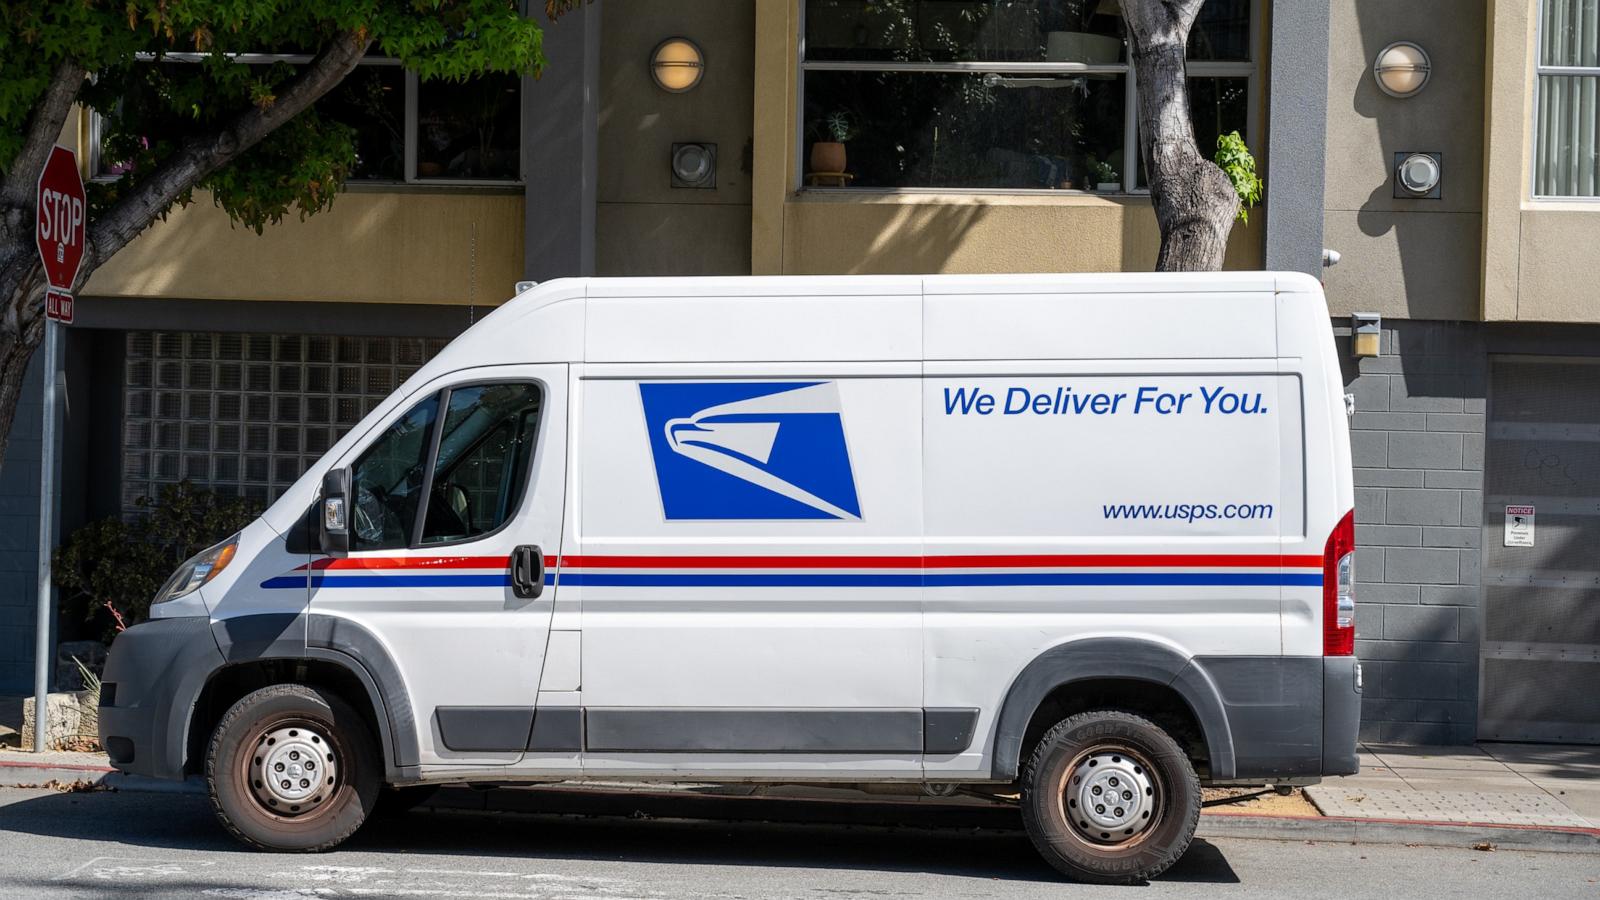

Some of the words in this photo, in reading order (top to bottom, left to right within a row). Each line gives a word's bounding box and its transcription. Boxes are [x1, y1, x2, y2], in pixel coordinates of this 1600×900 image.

[41, 188, 82, 246] STOP
[48, 297, 59, 315] ALL
[60, 299, 72, 317] WAY
[943, 387, 995, 415] We
[1003, 386, 1127, 415] Deliver
[1134, 386, 1193, 415] For
[1200, 386, 1268, 414] You.
[1102, 503, 1273, 523] www.usps.com
